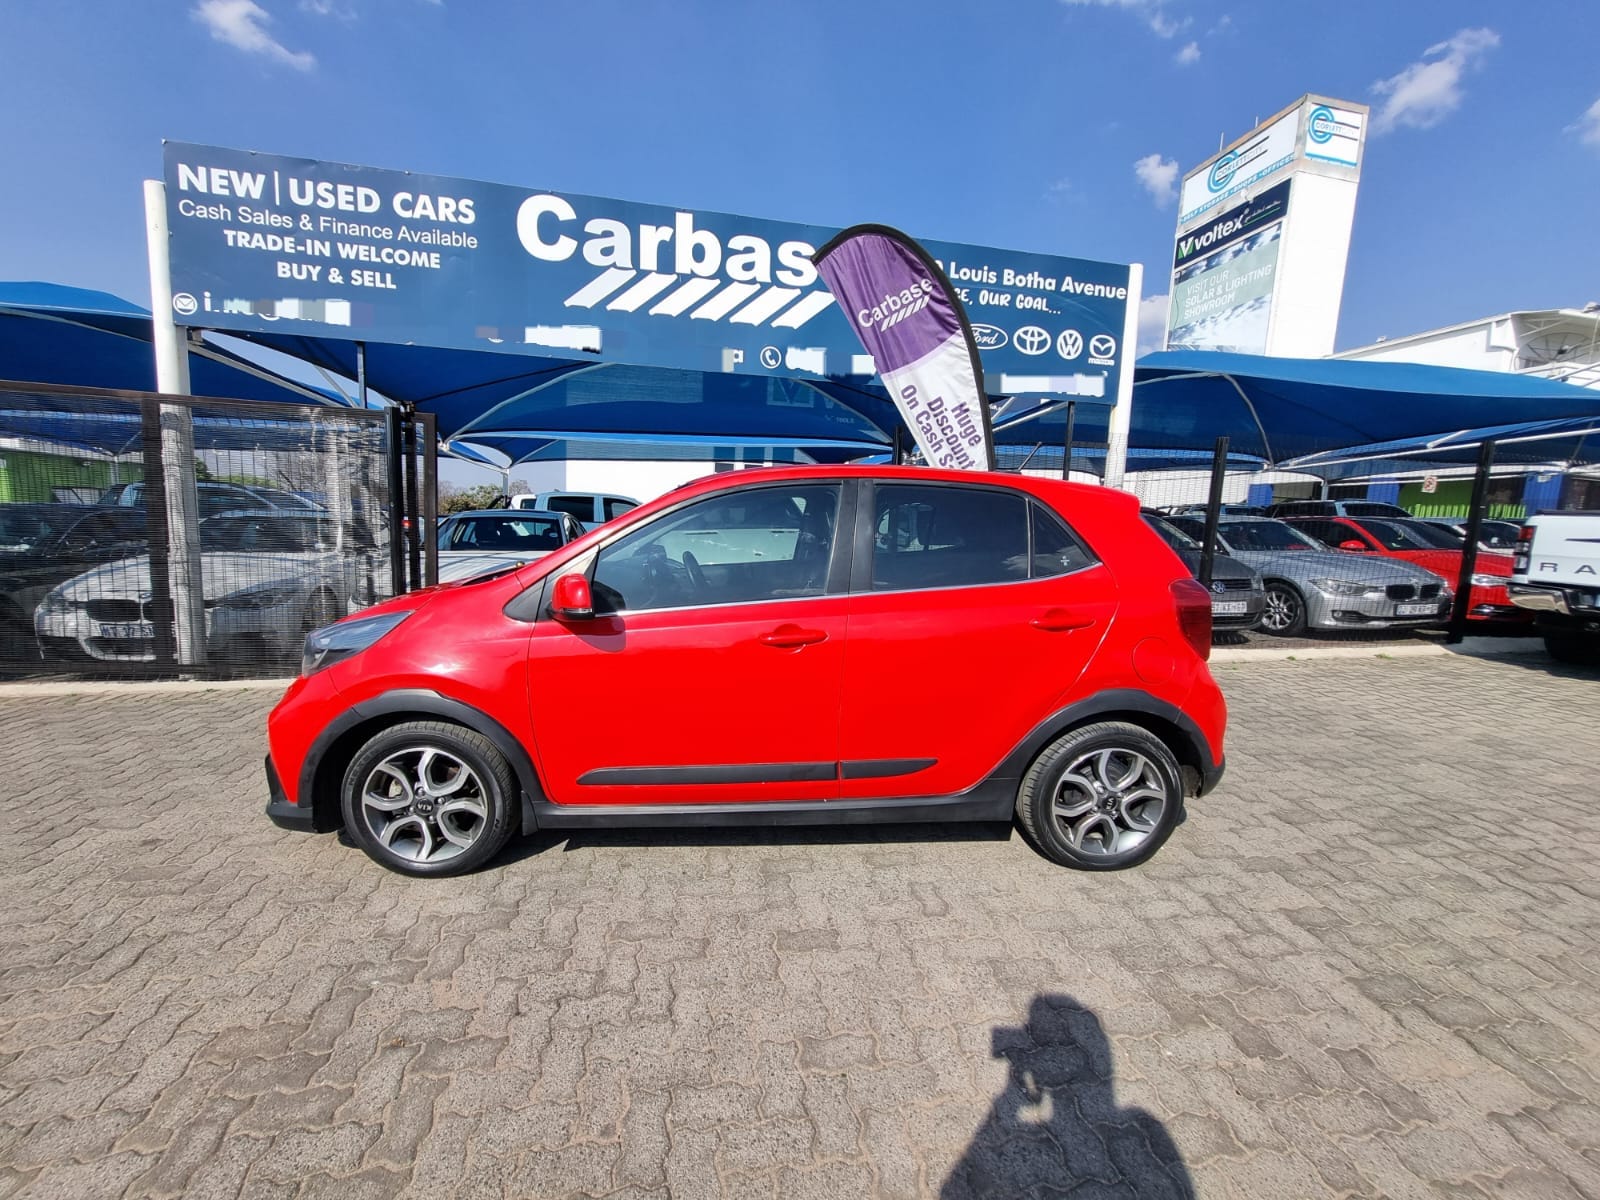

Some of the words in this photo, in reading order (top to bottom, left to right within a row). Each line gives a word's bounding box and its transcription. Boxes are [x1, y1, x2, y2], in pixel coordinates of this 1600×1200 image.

[177, 163, 265, 199] NEW
[289, 177, 381, 213] USED
[392, 191, 476, 225] CARS
[178, 199, 231, 222] Cash
[238, 205, 293, 229] Sales
[299, 215, 313, 231] &
[320, 215, 393, 240] Finance
[397, 228, 478, 249] Available
[516, 193, 819, 287] Carbas
[1194, 214, 1243, 251] voltex
[224, 229, 331, 257] TRADE-IN
[337, 241, 441, 269] WELCOME
[276, 261, 322, 282] BUY
[328, 267, 345, 285] &
[351, 270, 397, 289] SELL
[950, 261, 997, 284] Louis
[1003, 268, 1056, 292] Botha
[1061, 276, 1127, 300] Avenue
[1184, 288, 1214, 308] SOLAR
[1215, 284, 1223, 296] &
[1225, 263, 1272, 293] LIGHTING
[1187, 278, 1209, 297] VISIT
[1209, 269, 1229, 287] OUR
[858, 278, 933, 328] Carbase
[979, 290, 1011, 307] OUR
[1183, 291, 1236, 320] SHOWROOM
[901, 384, 919, 410] On
[915, 410, 945, 454] Cash
[927, 395, 976, 470] Discount
[951, 401, 982, 447] Huge
[417, 803, 433, 811] KIA
